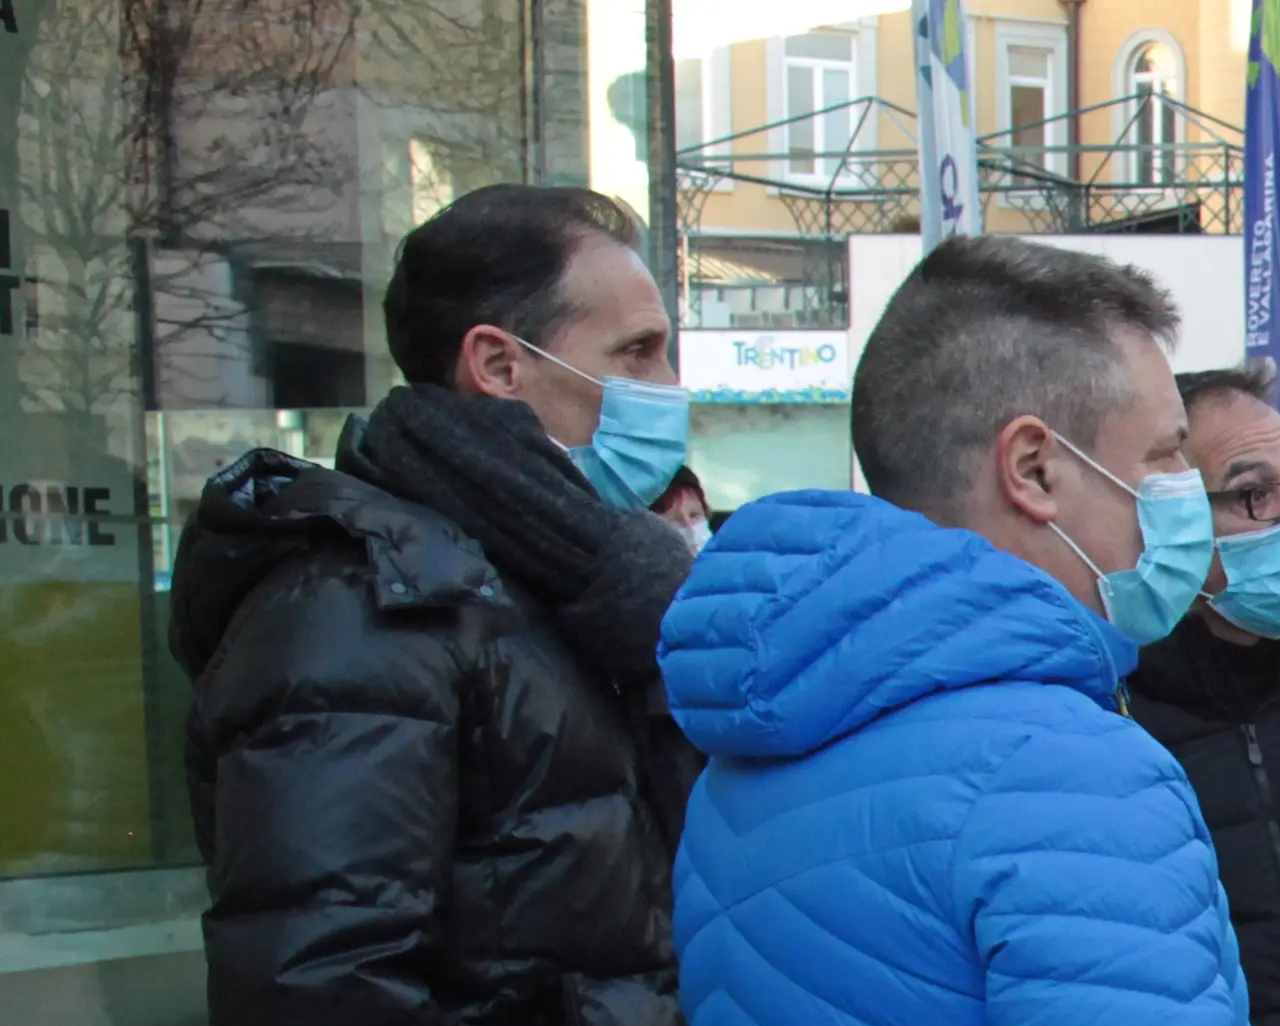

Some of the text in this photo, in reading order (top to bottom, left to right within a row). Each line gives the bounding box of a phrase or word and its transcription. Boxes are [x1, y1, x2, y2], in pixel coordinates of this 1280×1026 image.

[1246, 219, 1266, 348] ROVERETO
[1257, 330, 1270, 346] E
[733, 341, 836, 370] TRENTINO
